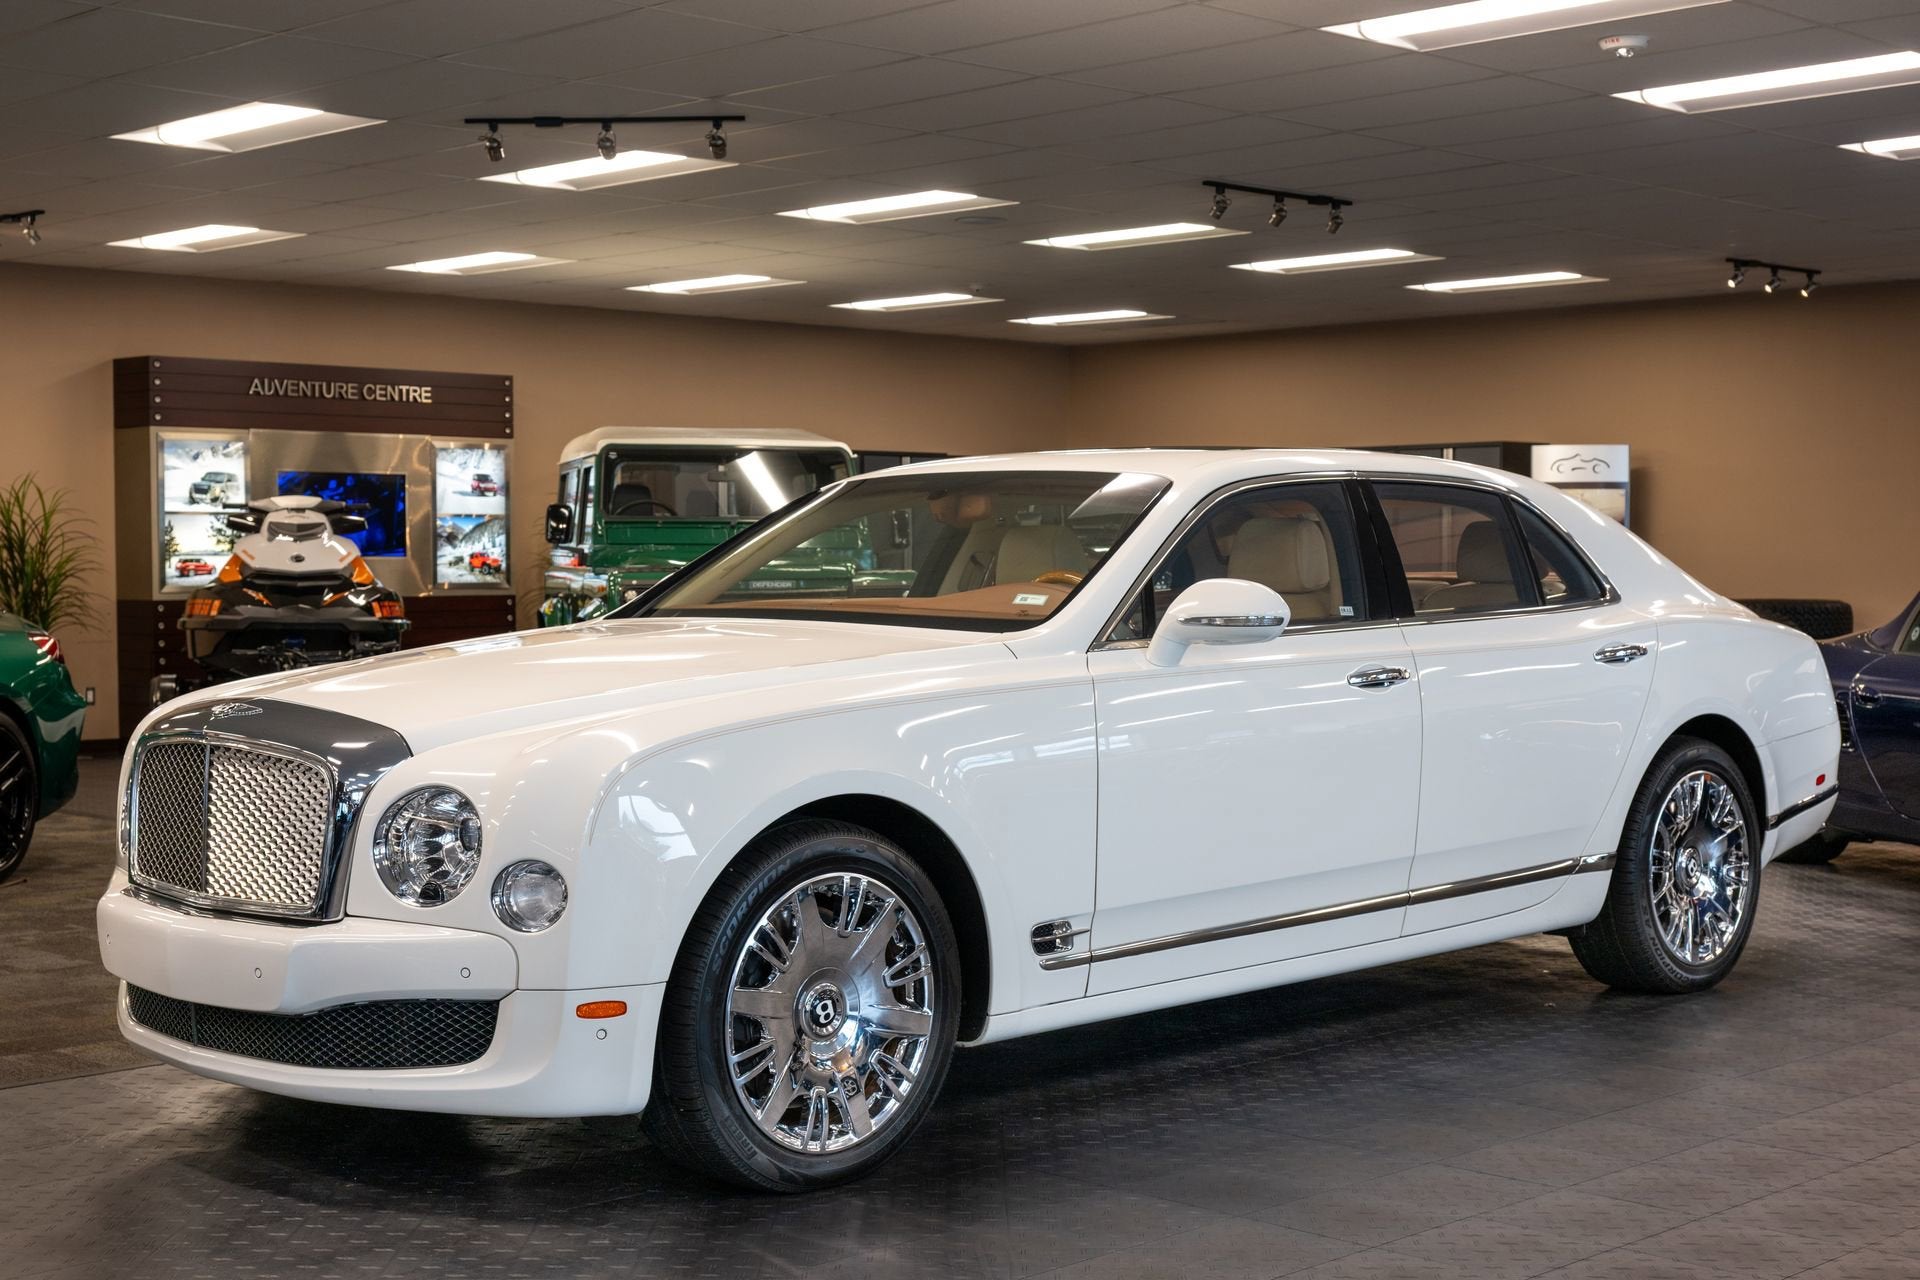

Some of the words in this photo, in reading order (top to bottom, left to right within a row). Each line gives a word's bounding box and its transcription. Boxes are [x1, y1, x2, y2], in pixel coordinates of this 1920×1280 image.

[249, 378, 358, 399] ADVENTURE
[362, 383, 432, 403] CENTRE
[711, 859, 791, 974] SCORPION
